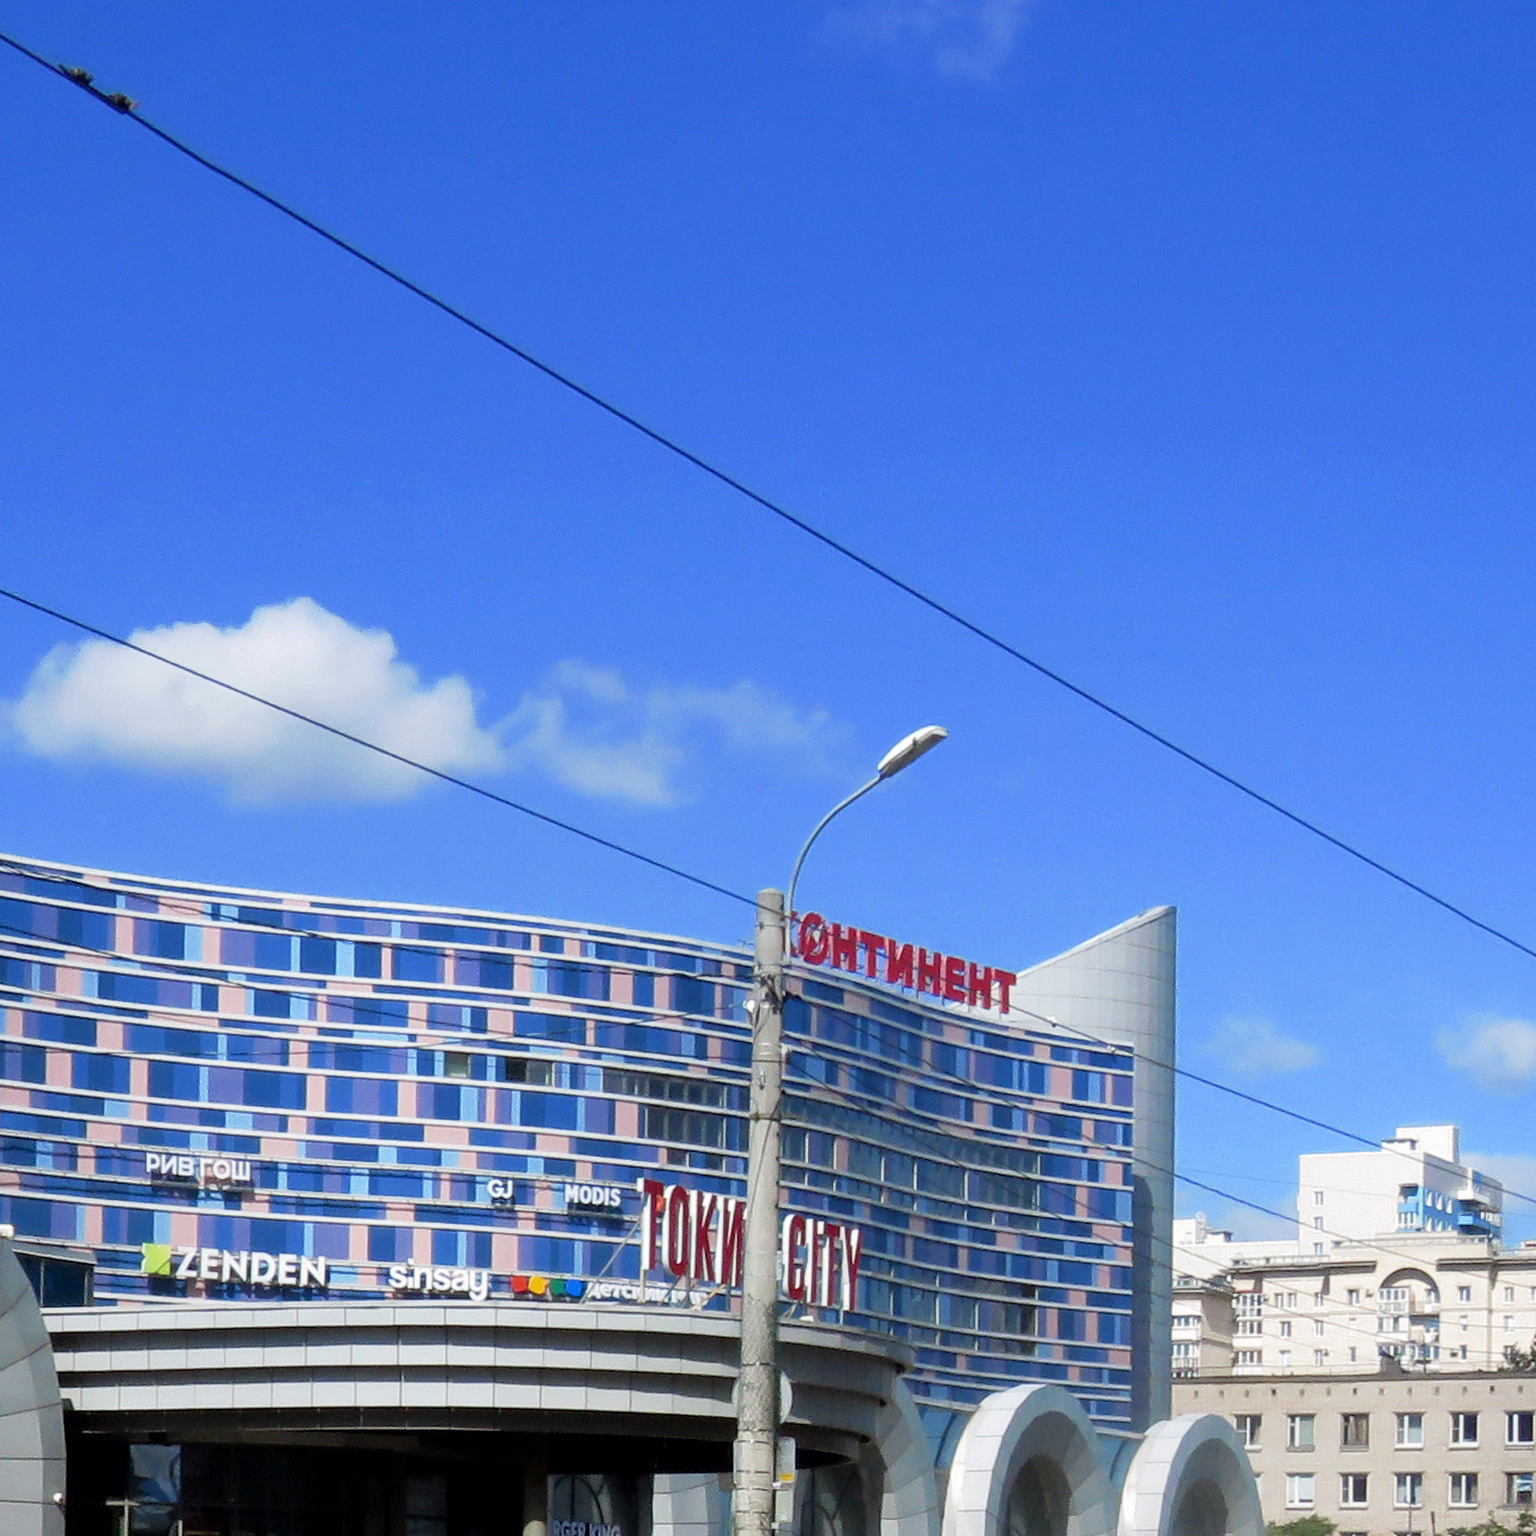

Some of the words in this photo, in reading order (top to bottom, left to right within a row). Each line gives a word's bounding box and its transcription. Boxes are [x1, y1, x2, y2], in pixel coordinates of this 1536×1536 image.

[145, 1152, 194, 1178] РИВ
[199, 1156, 252, 1182] ГОШ
[486, 1178, 514, 1200] GJ
[565, 1183, 621, 1207] MODIS
[636, 1177, 747, 1288] ТОКИ
[782, 1213, 864, 1312] CITY
[175, 1246, 327, 1288] ZENDEN
[388, 1258, 489, 1301] sinsay
